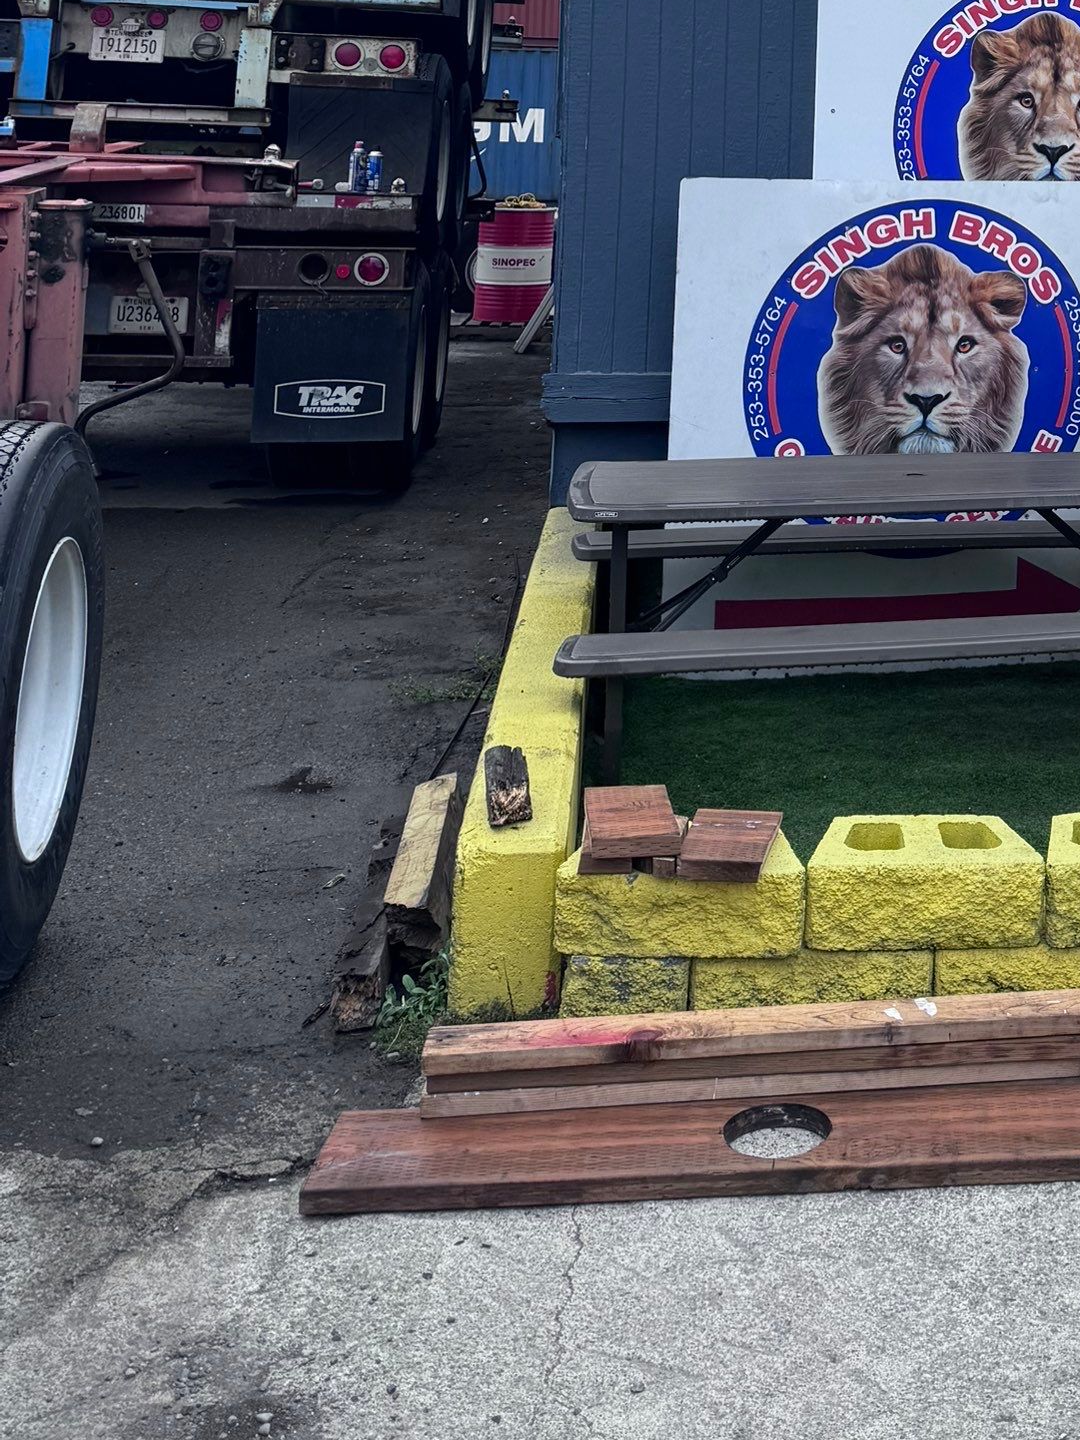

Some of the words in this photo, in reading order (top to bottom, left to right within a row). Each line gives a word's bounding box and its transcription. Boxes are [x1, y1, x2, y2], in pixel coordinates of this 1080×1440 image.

[99, 36, 157, 55] T912150
[897, 54, 930, 181] 253-353-5764
[100, 205, 141, 220] 236801
[491, 257, 536, 267] SINOPEC
[791, 207, 936, 300] SINGH
[949, 209, 1062, 305] BROS
[116, 305, 180, 323] U23648
[747, 295, 787, 441] 253-353-5764
[298, 385, 365, 407] TRAC
